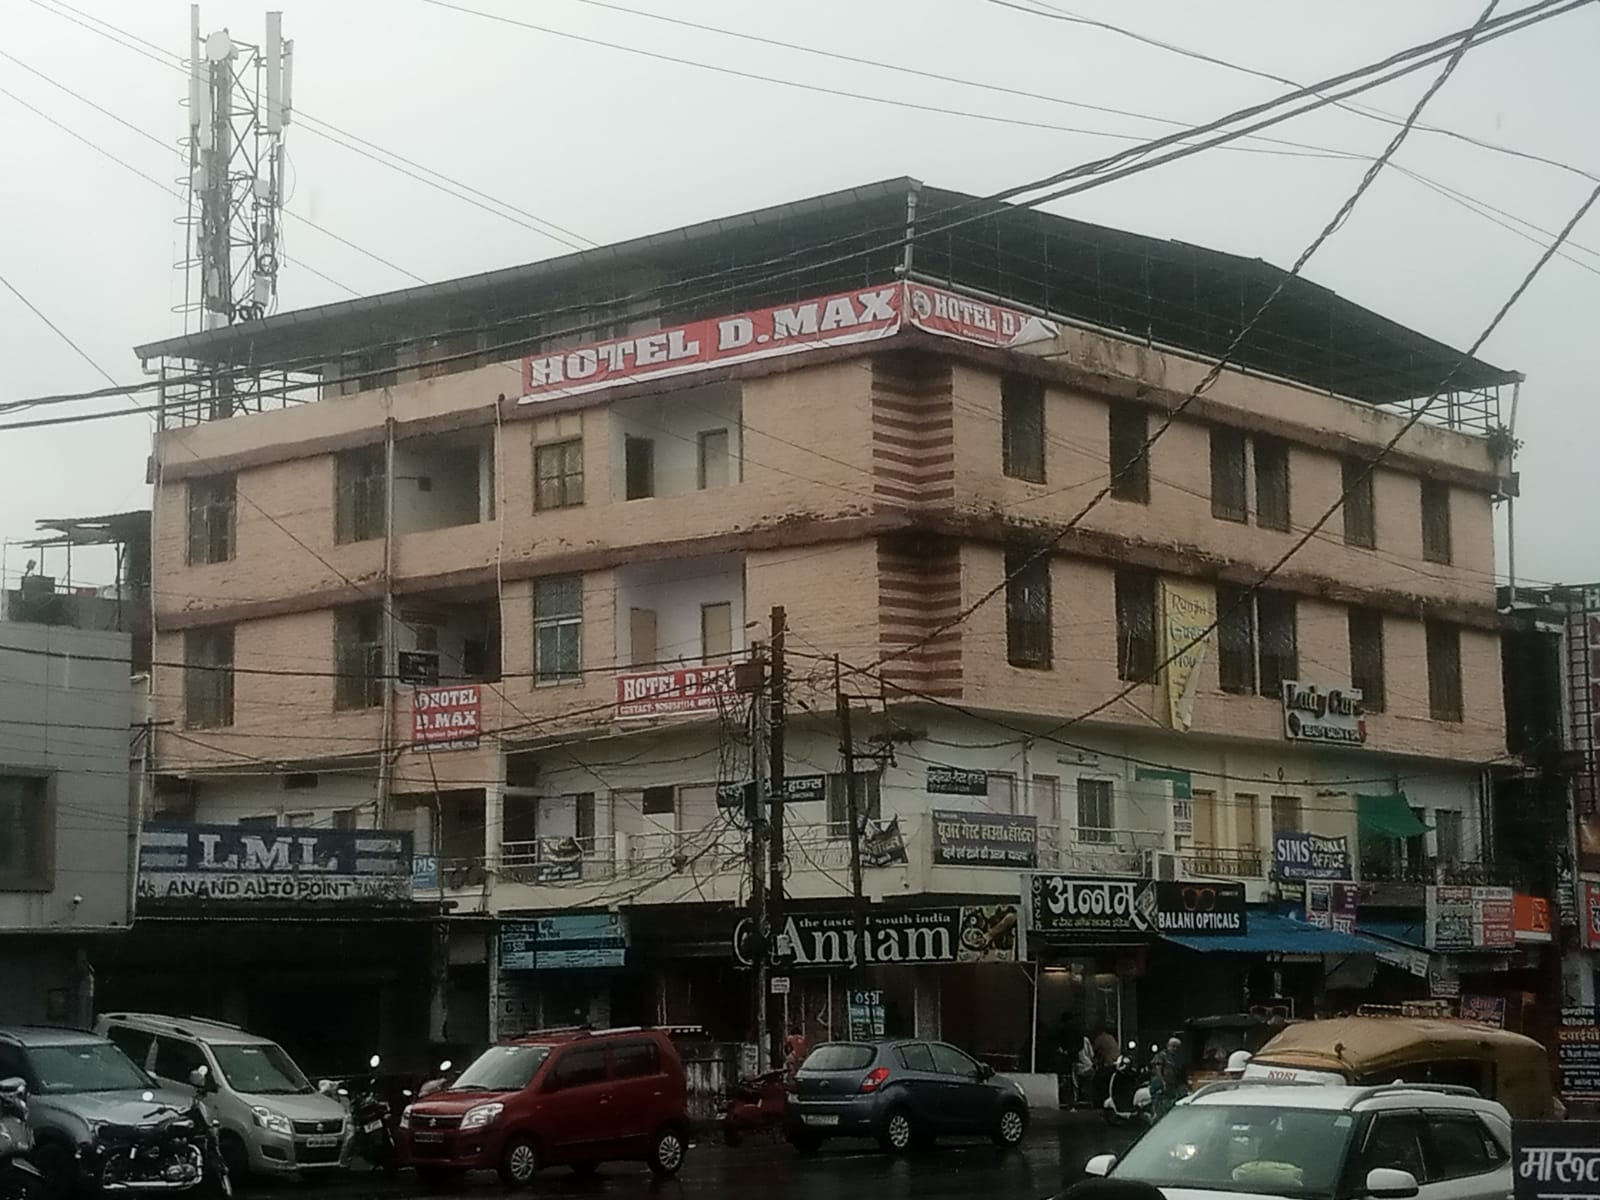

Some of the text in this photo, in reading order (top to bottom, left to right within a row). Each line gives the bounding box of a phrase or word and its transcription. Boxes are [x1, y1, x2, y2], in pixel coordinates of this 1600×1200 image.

[933, 293, 997, 333] HOTEL
[530, 288, 899, 387] HOTEL D.MAX
[430, 689, 477, 708] HOTEL
[623, 674, 680, 701] HOTEL
[197, 832, 338, 872] LML
[1277, 838, 1310, 863] SIMS
[1311, 852, 1345, 869] OFFICE
[167, 880, 239, 897] ANAND
[244, 880, 296, 897] AUTO
[298, 881, 353, 897] POINT
[799, 917, 820, 928] the
[915, 912, 951, 924] india
[1158, 911, 1240, 929] BALANI OPTICALS
